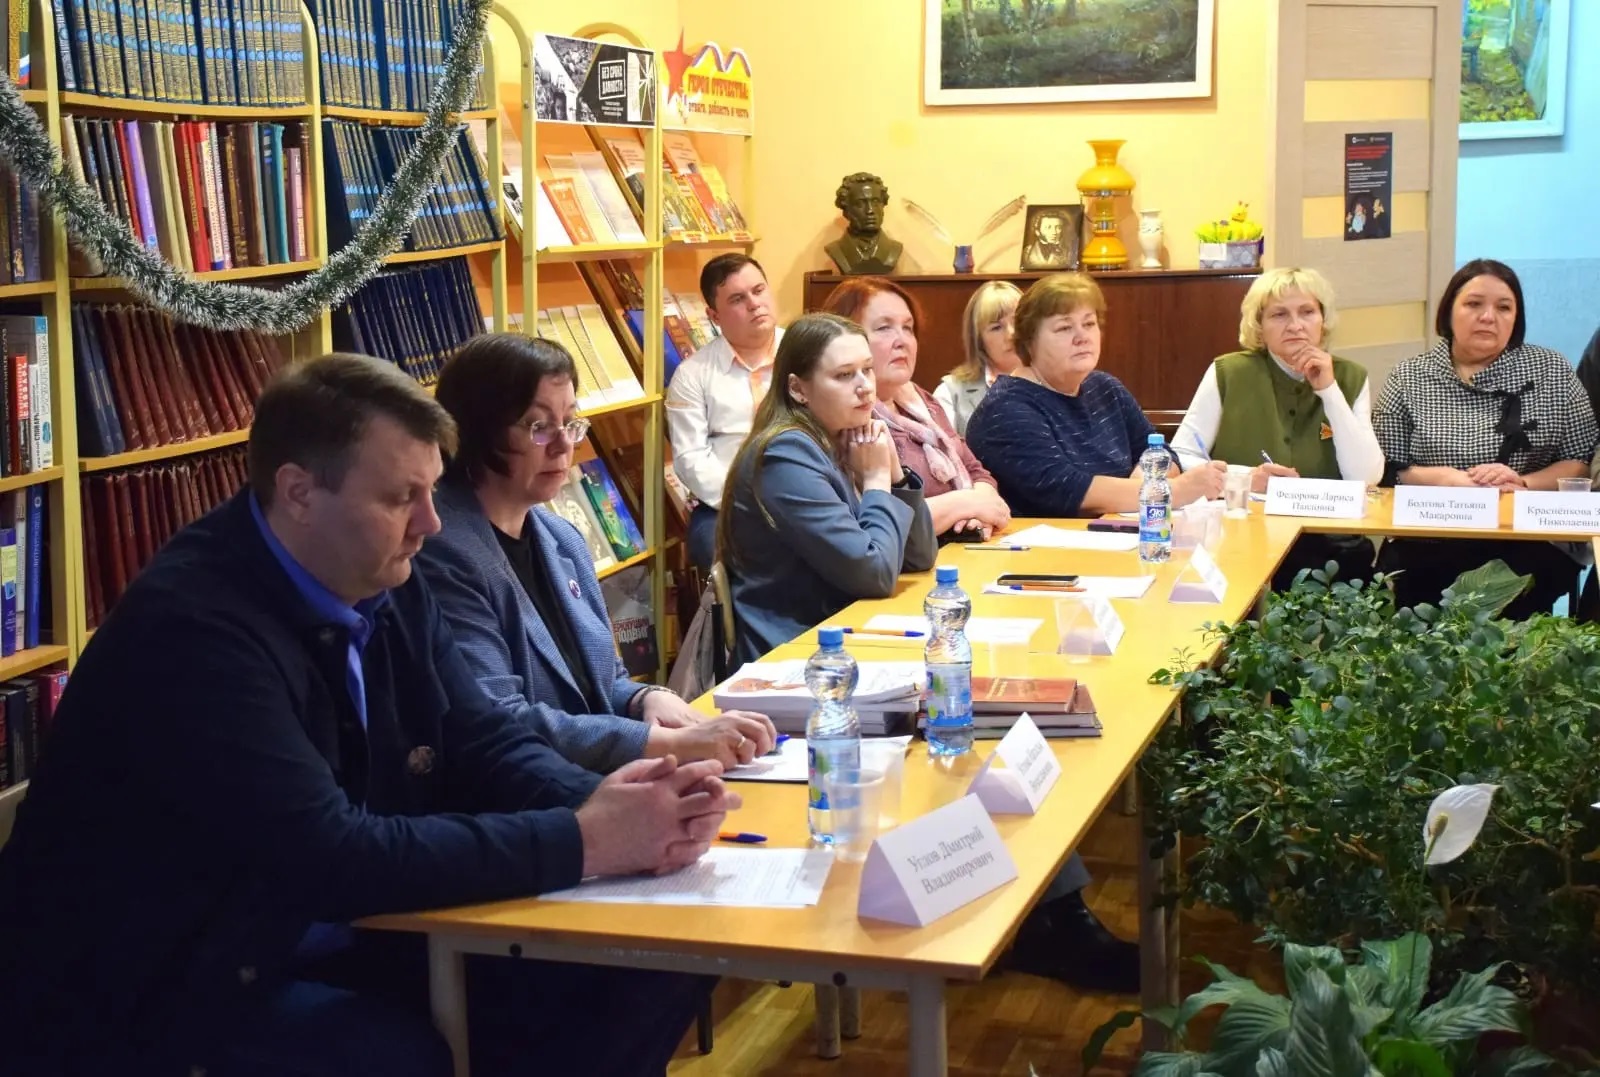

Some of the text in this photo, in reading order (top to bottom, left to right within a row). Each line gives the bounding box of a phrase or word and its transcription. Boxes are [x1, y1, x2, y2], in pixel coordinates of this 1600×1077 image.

[1320, 492, 1354, 503] Лариса
[1447, 499, 1486, 510] Татьяна
[1419, 510, 1473, 522] Макаровна
[1539, 517, 1599, 528] Николаевна
[907, 825, 984, 872] Углов Дмитрий
[921, 851, 994, 894] Владимирович
